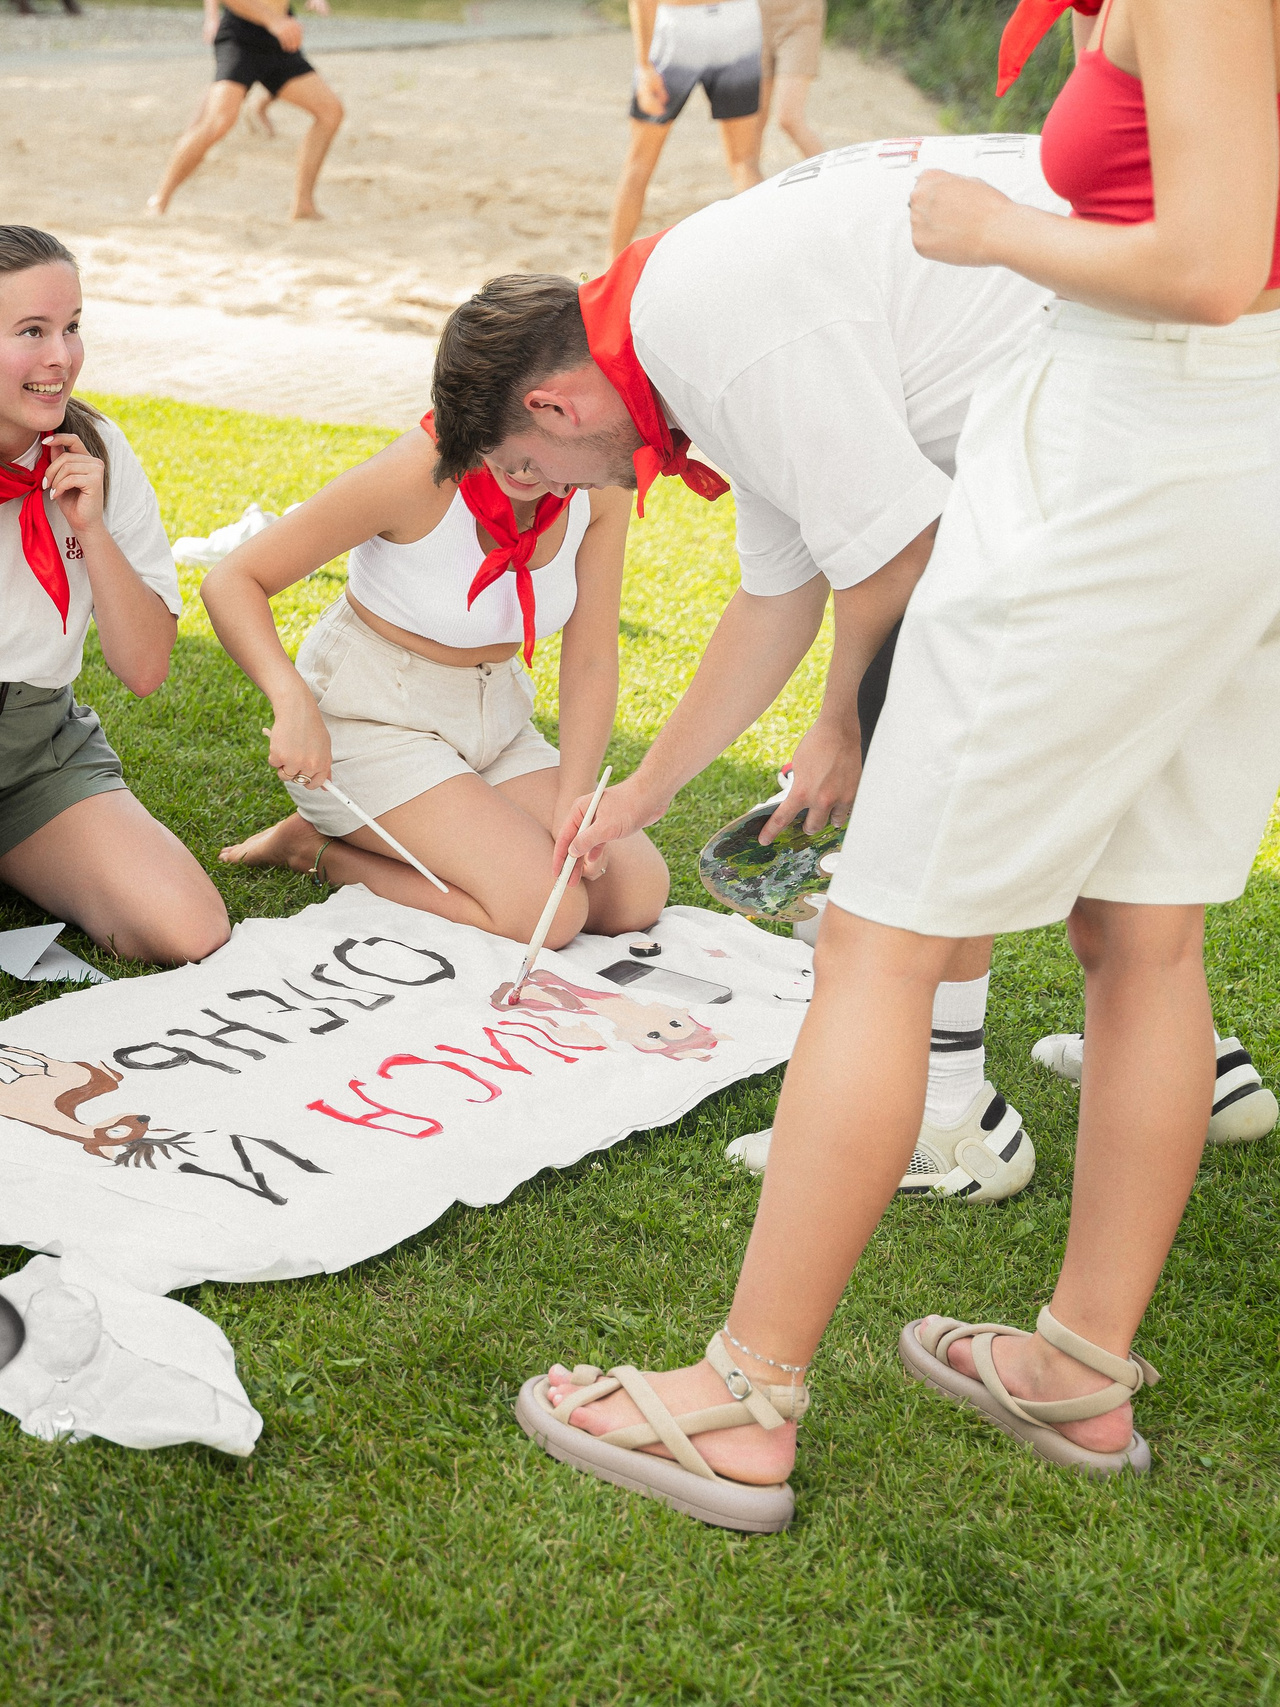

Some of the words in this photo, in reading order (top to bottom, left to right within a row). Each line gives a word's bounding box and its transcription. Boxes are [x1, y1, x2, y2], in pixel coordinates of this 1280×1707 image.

[112, 936, 456, 1075] ОЛЕНЬ
[306, 1018, 607, 1140] ЛИСА
[177, 1133, 333, 1206] И
